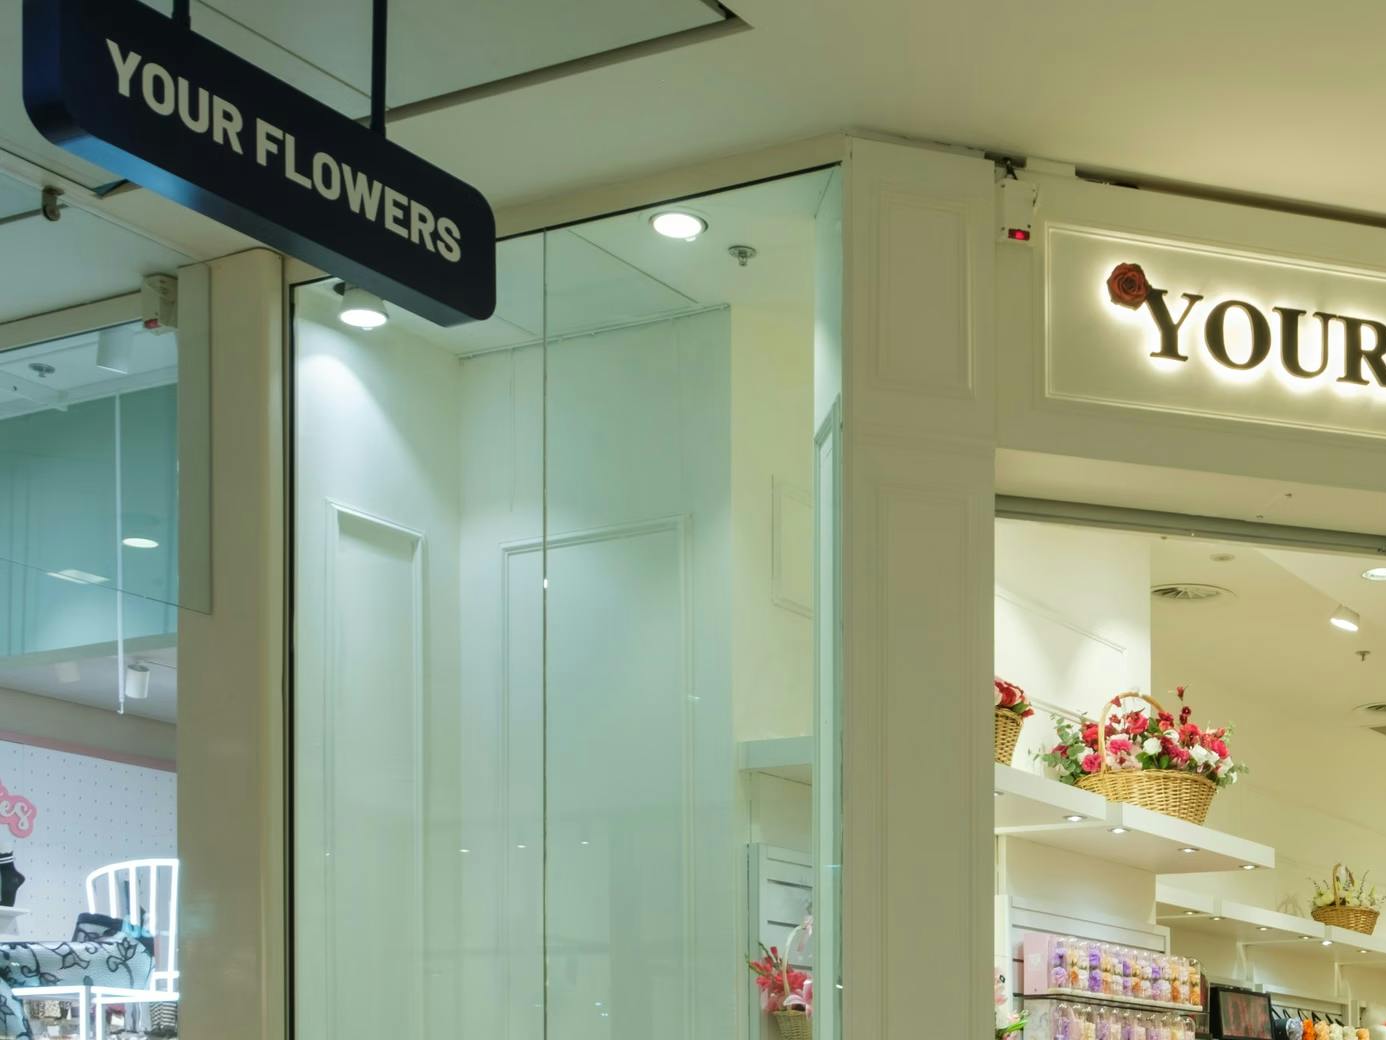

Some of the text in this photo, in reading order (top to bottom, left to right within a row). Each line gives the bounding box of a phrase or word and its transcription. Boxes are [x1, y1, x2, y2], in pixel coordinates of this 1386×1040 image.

[106, 38, 462, 263] YOUR FLOWERS
[0, 799, 33, 831] es
